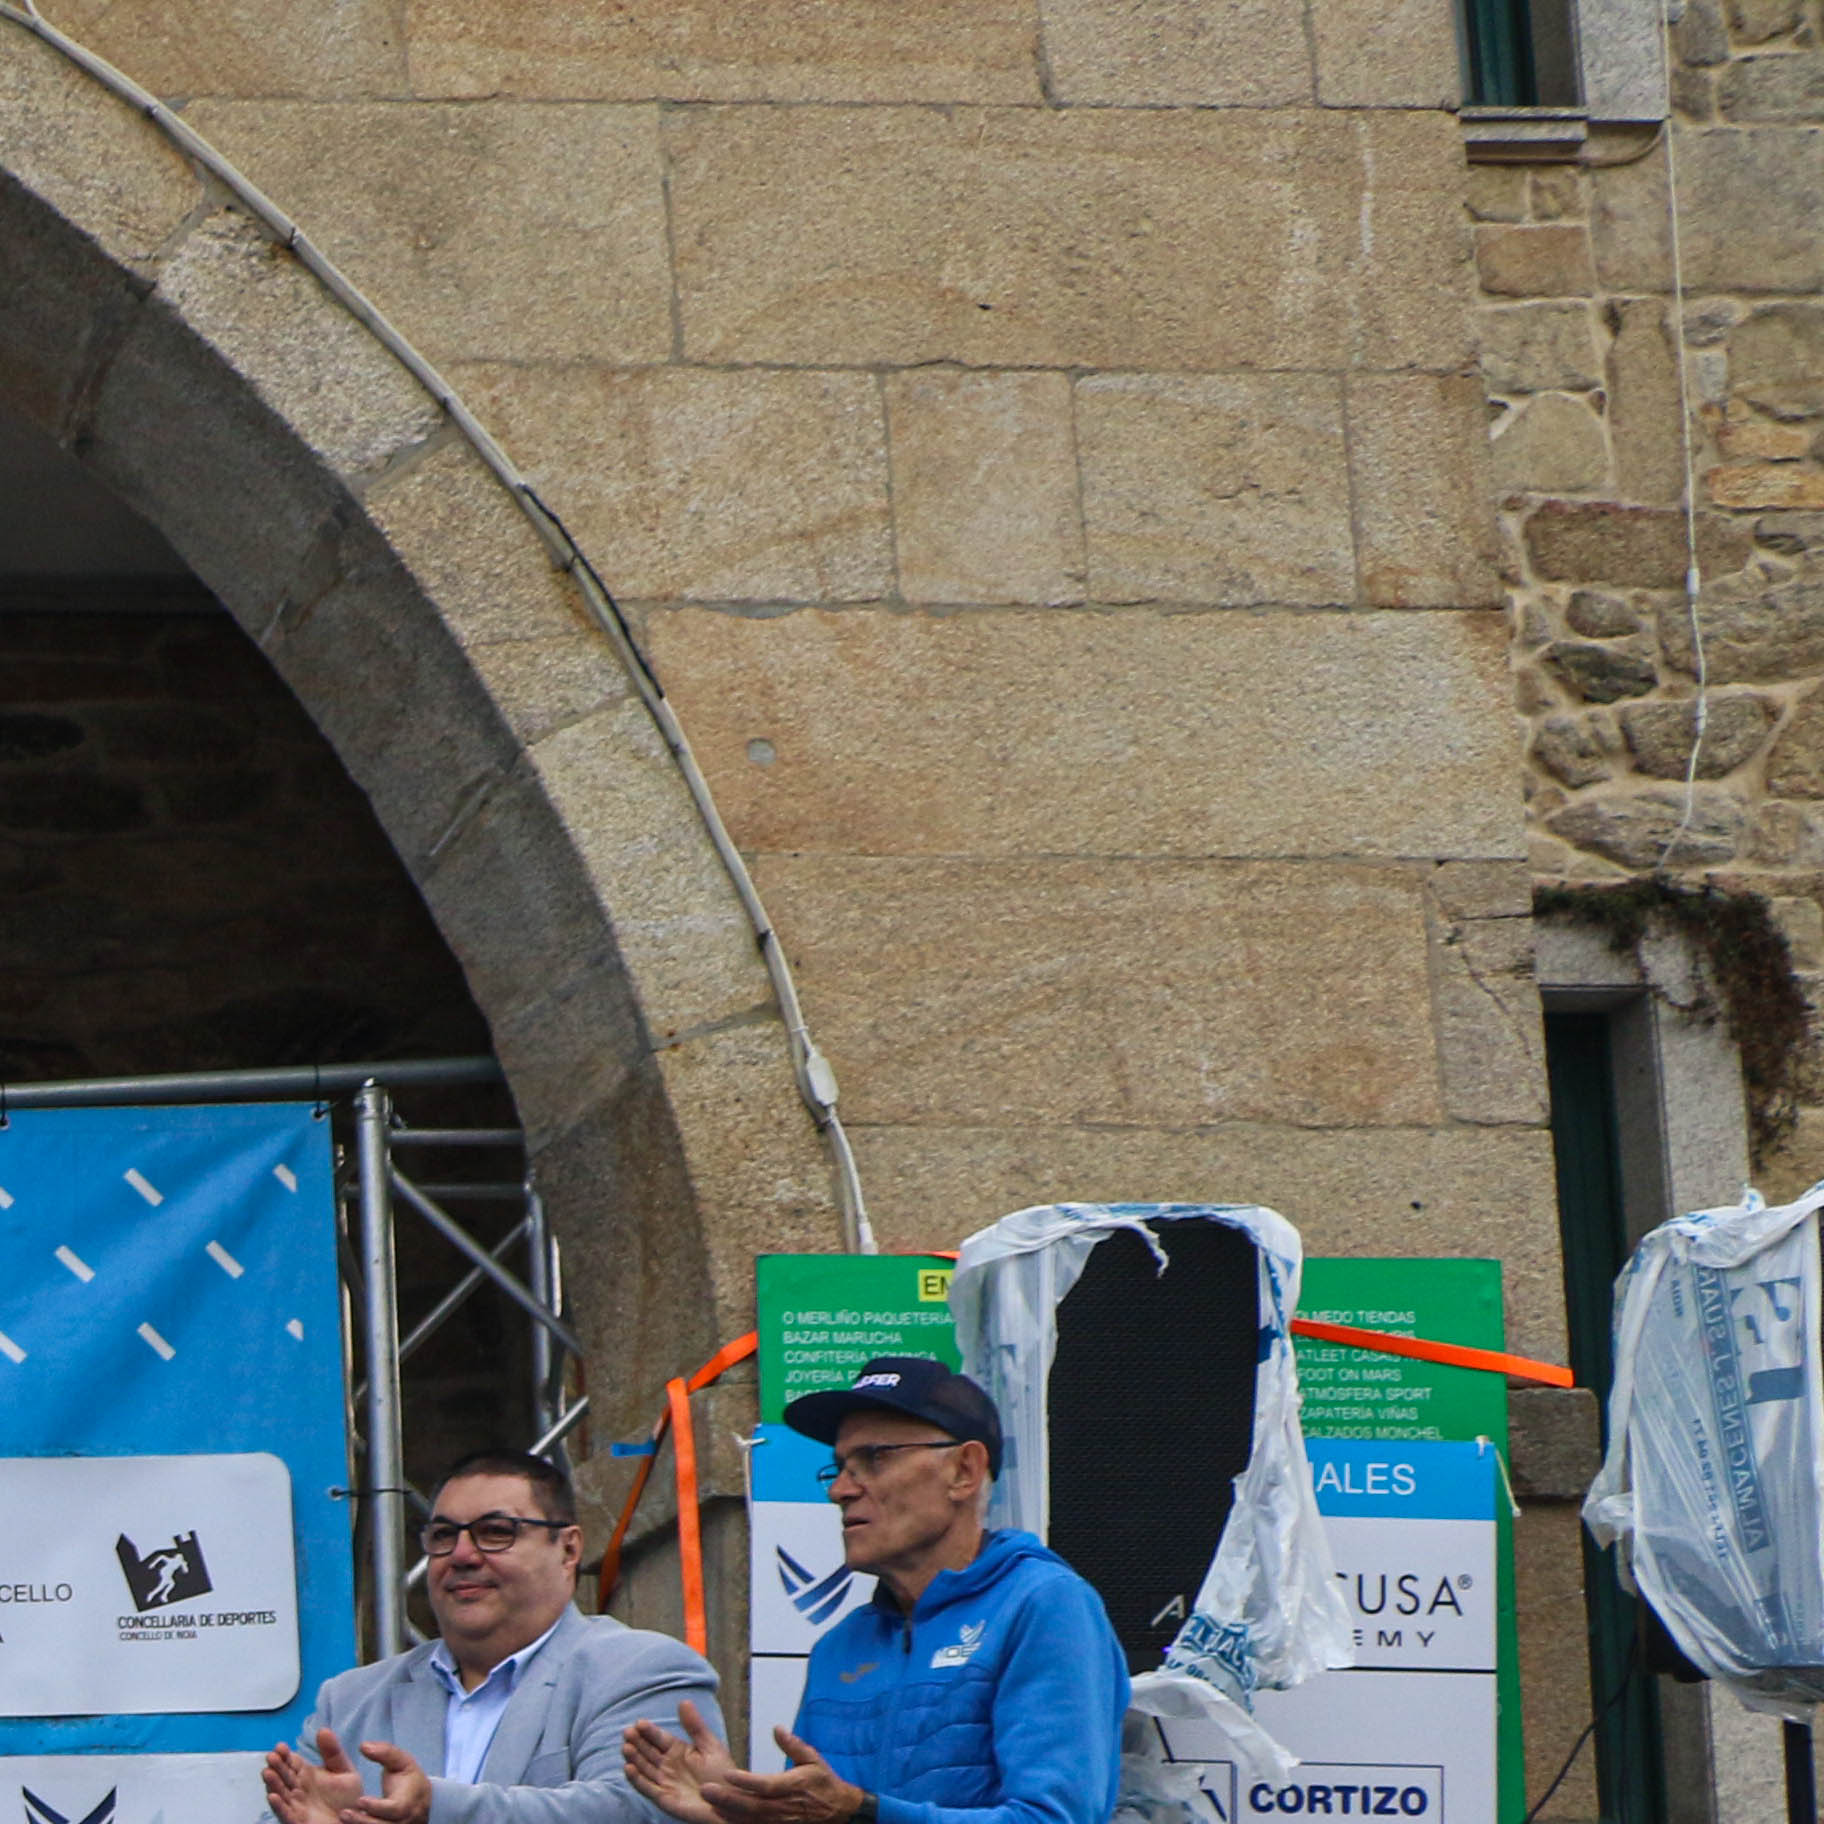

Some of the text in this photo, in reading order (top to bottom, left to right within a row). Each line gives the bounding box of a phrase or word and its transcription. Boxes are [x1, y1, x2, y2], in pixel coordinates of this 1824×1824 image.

[783, 1331, 829, 1344] BAZAR
[118, 1611, 277, 1629] CONCELLARIA DE DEPORTES
[1249, 1782, 1429, 1817] CORTIZO
